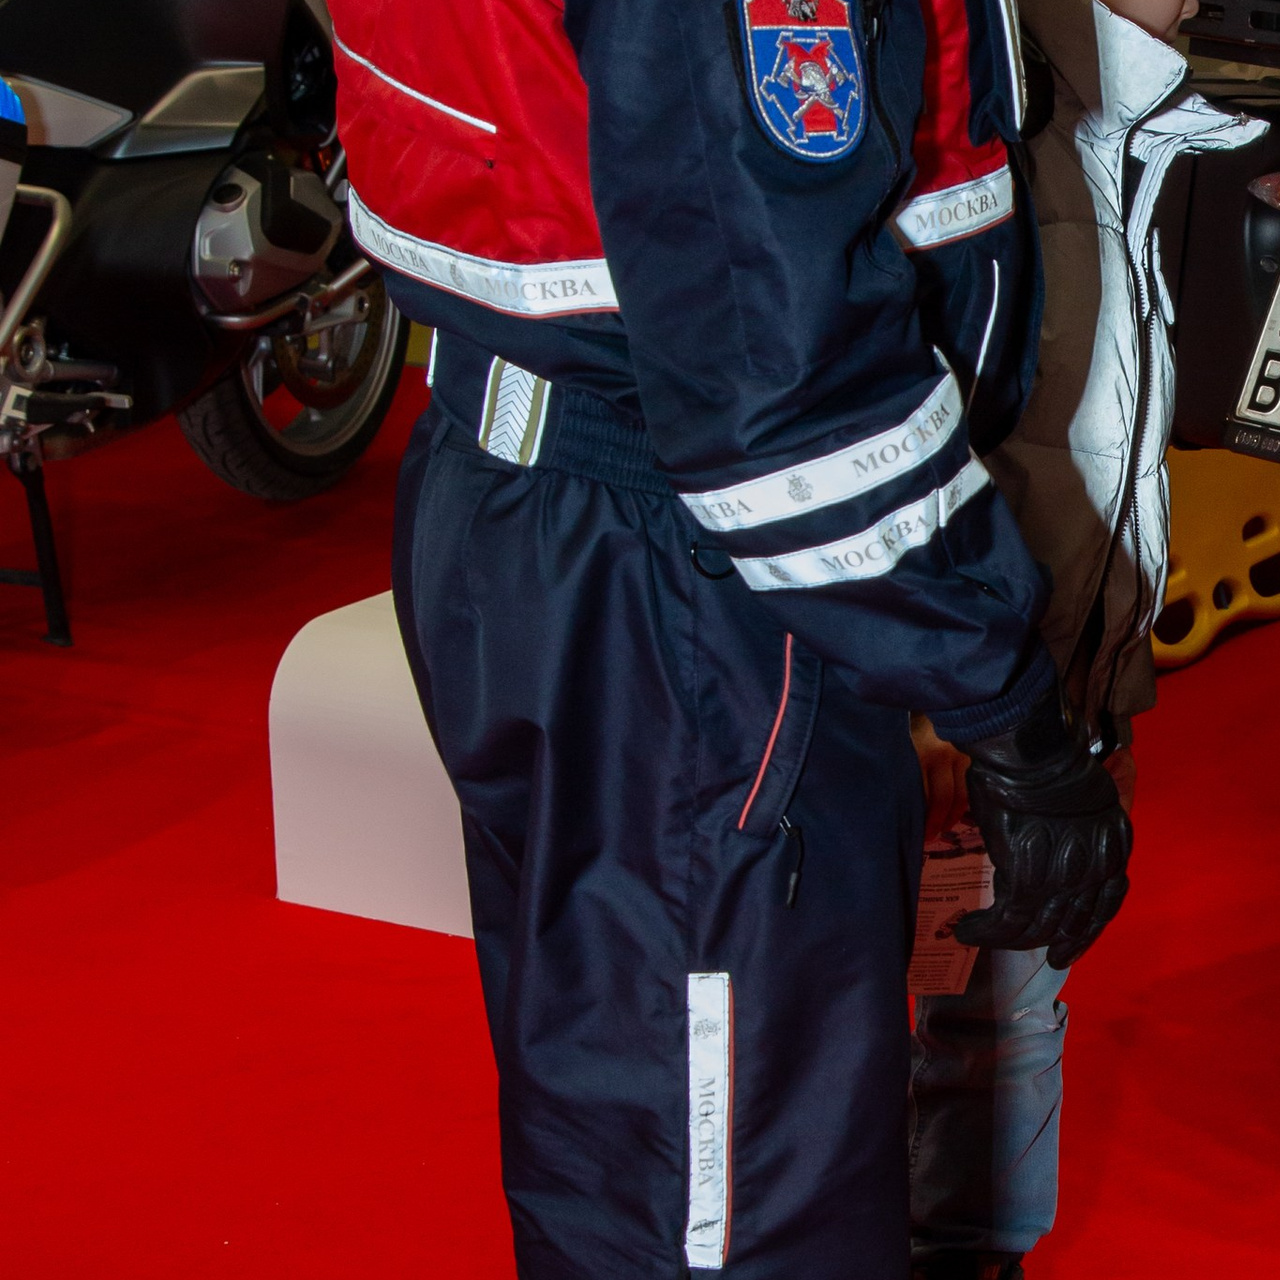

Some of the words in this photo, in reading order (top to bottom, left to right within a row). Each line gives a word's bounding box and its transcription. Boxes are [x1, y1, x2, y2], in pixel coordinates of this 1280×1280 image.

[915, 192, 999, 232] МОСКВА
[371, 229, 430, 273] МОСКВА
[484, 277, 598, 302] МОСКВА
[851, 402, 951, 478] МОСКВА
[820, 513, 931, 572] МОСКВА
[697, 1077, 716, 1187] МОСКВА
